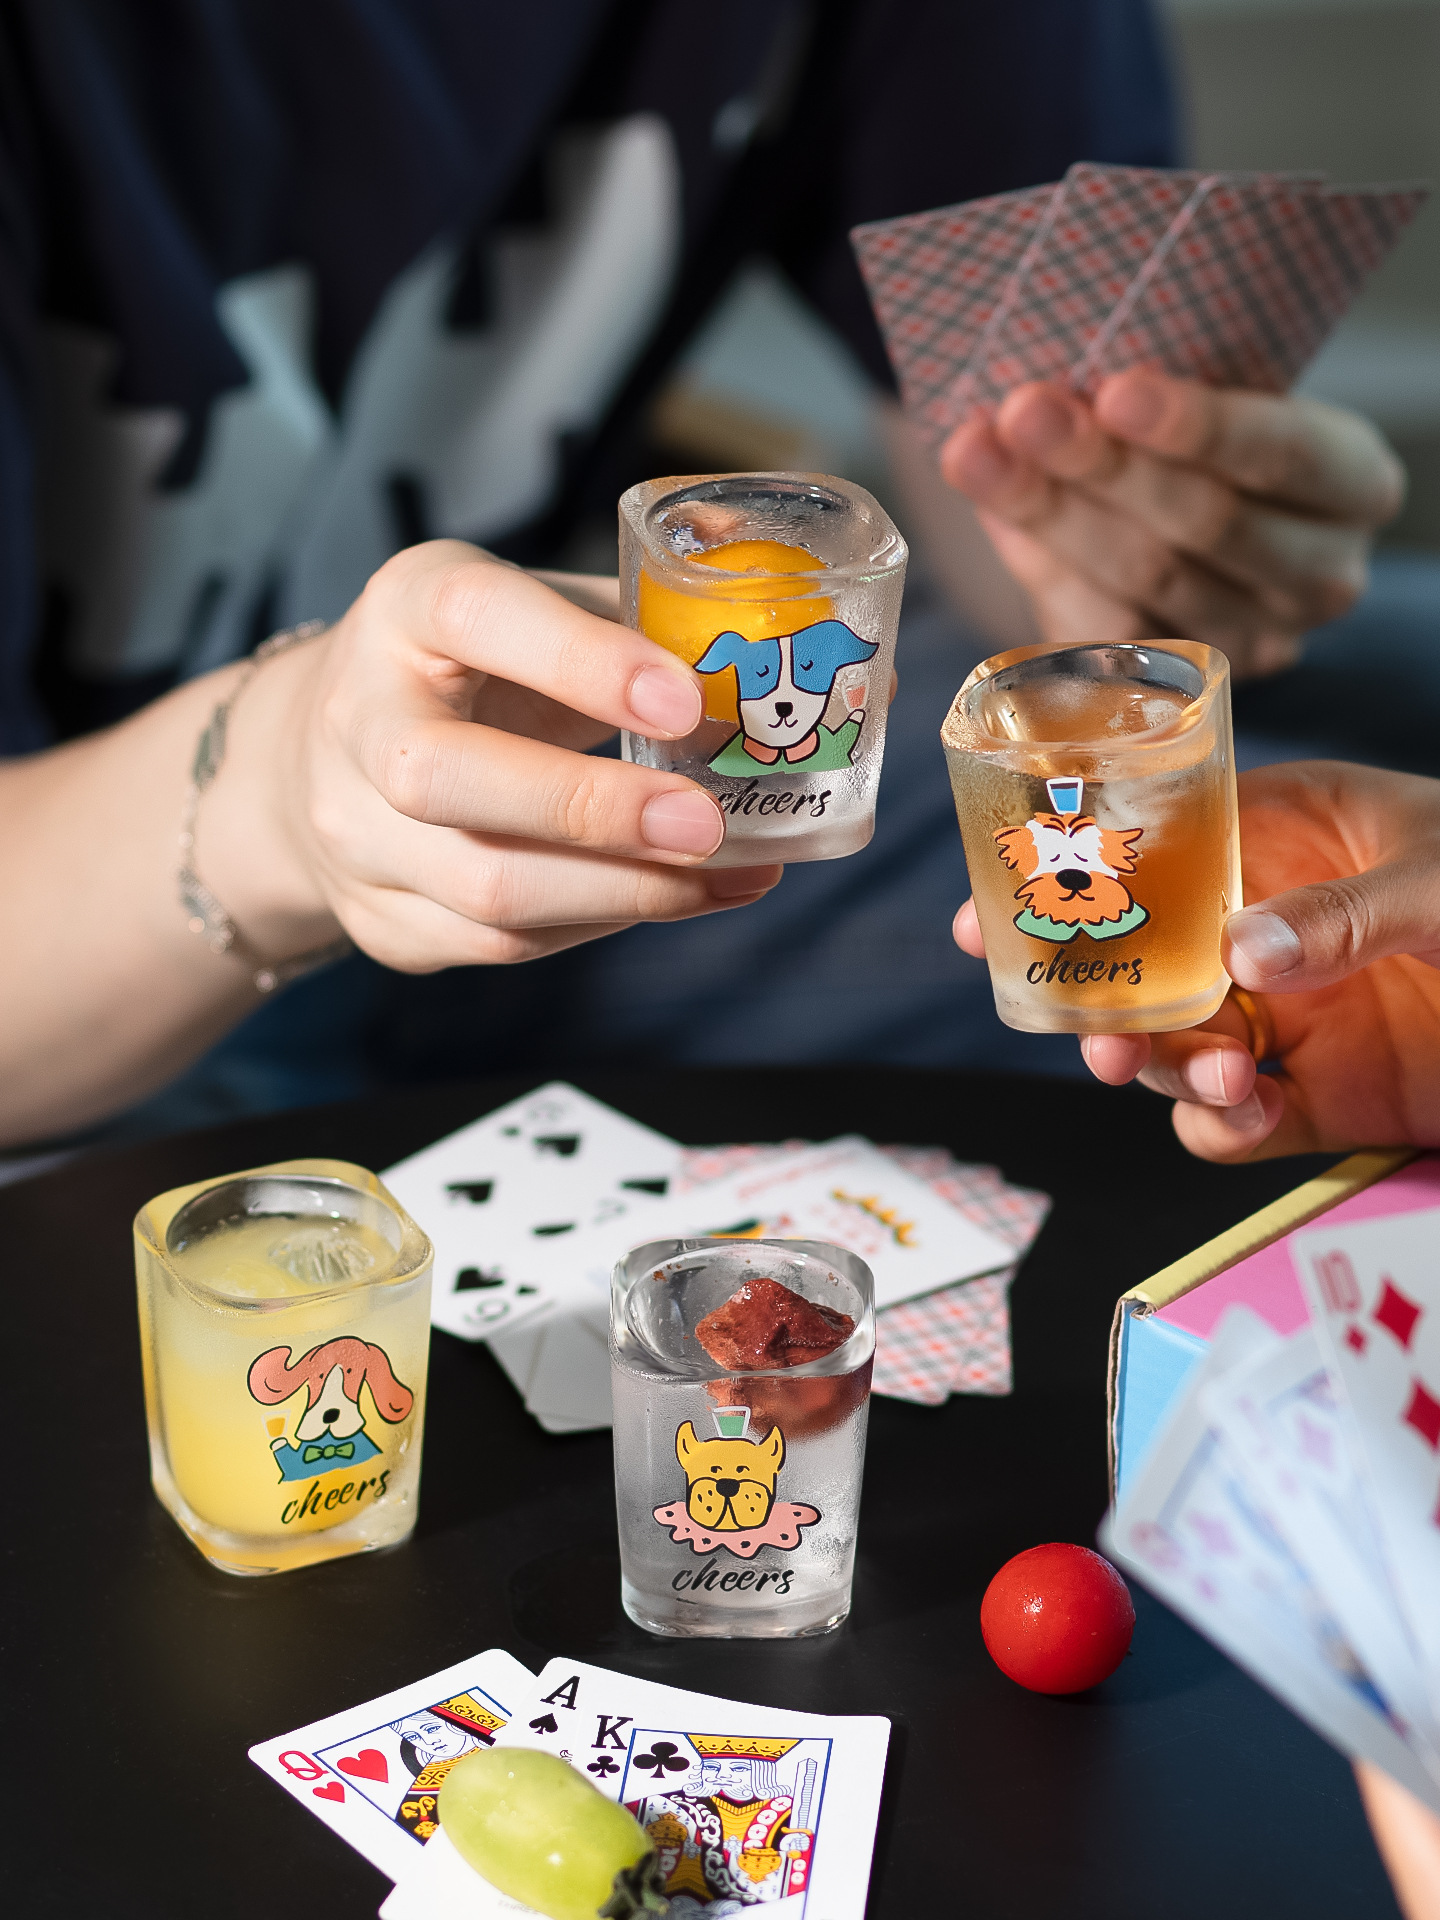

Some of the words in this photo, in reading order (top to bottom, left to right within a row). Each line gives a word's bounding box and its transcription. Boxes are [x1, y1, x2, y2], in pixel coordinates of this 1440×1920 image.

[718, 779, 832, 818] cheers
[1026, 947, 1145, 985] cheers
[281, 1469, 391, 1524] cheers
[671, 1558, 795, 1594] cheers
[539, 1675, 581, 1710] A
[590, 1714, 634, 1751] K
[278, 1750, 329, 1781] Q
